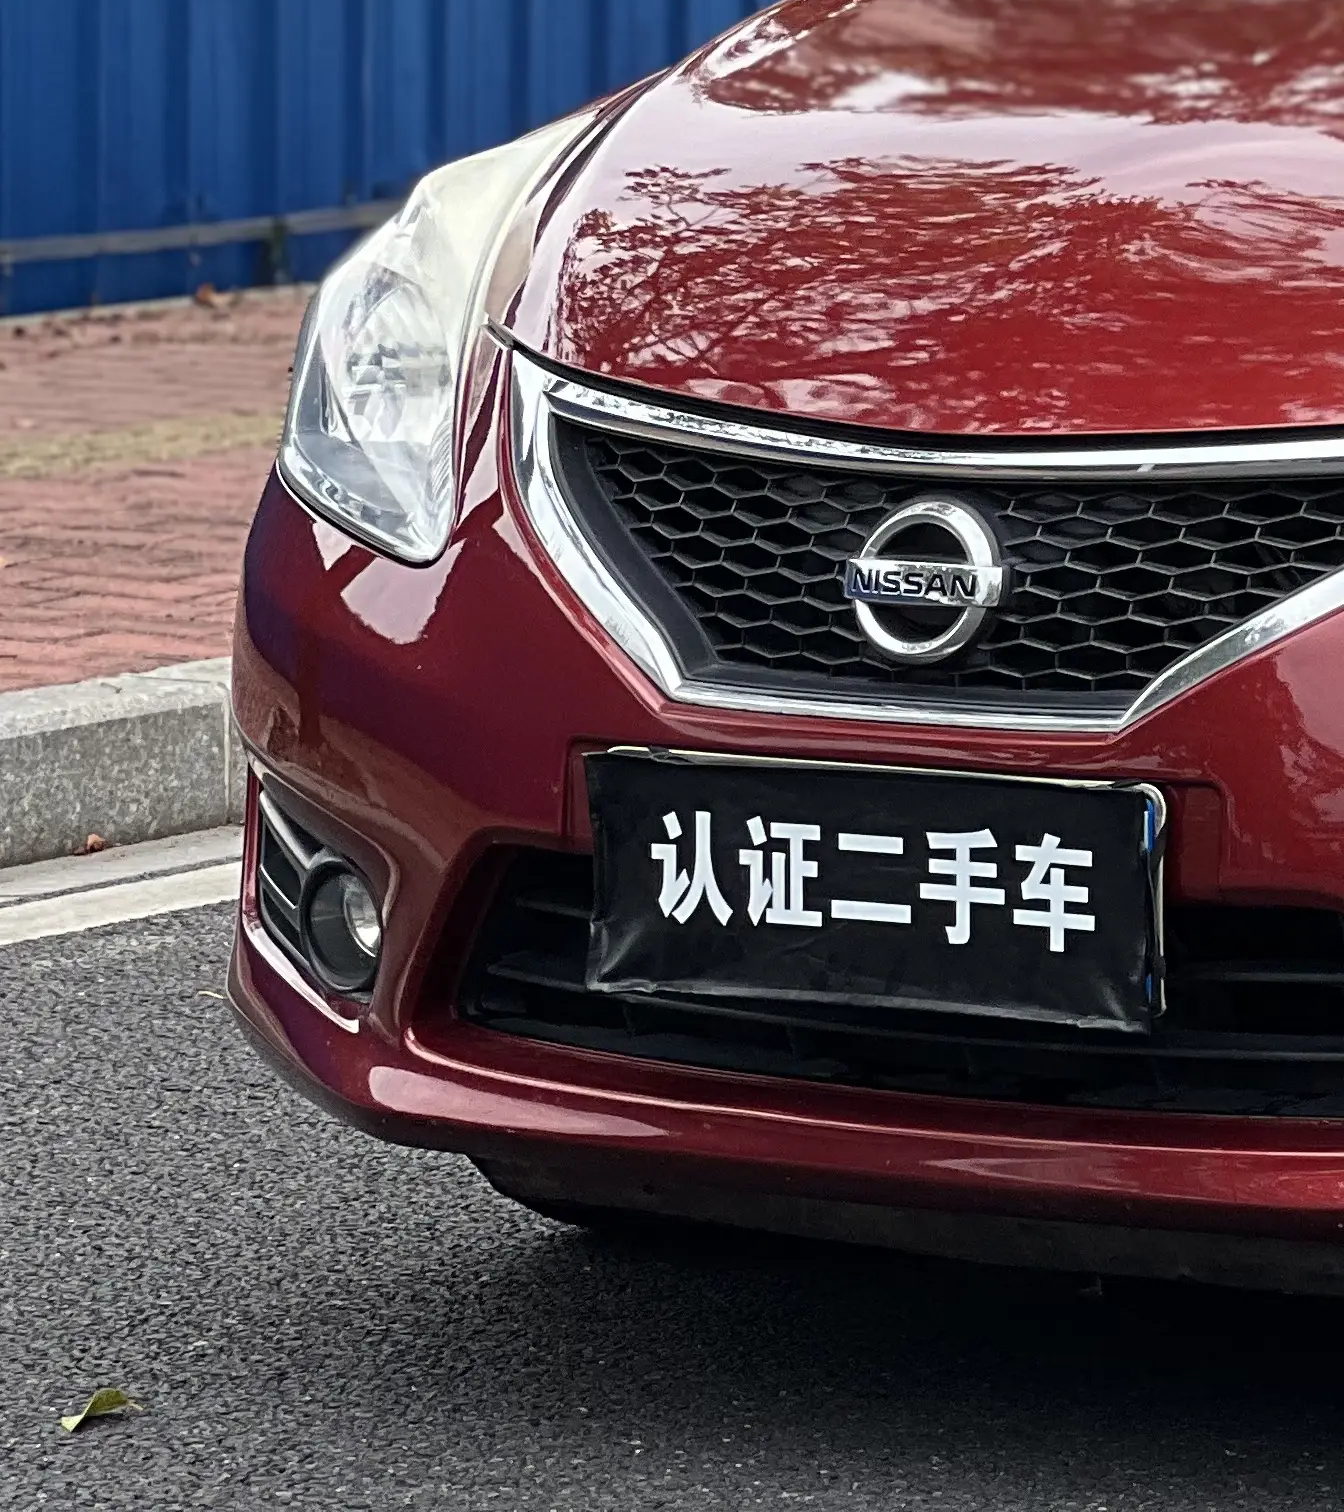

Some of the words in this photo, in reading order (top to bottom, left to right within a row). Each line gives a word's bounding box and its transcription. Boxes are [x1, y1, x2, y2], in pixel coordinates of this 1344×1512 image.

[851, 569, 977, 598] NISSAN
[650, 810, 1096, 953] 认证二手车
